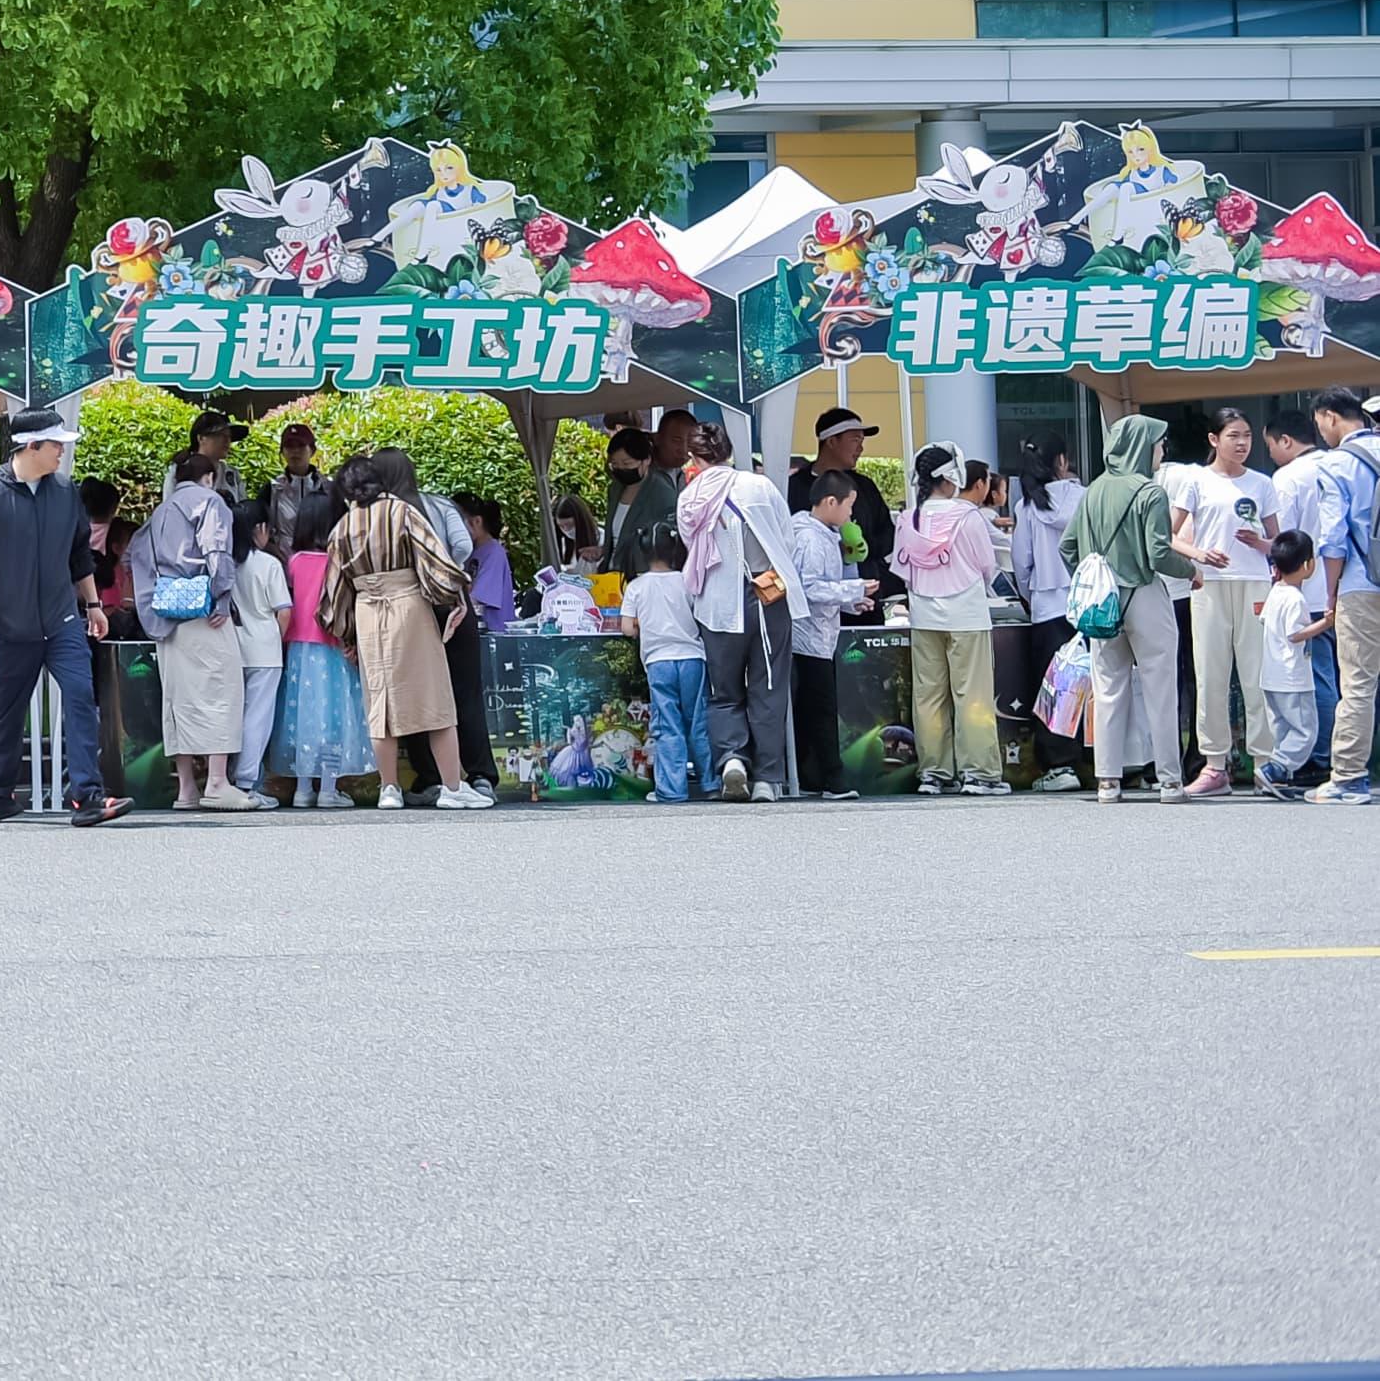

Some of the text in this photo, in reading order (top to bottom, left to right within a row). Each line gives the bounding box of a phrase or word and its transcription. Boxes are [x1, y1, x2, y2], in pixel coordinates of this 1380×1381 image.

[142, 303, 602, 383] 奇趣手工坊
[896, 282, 1249, 366] 非遗草编
[863, 638, 888, 647] TCL
